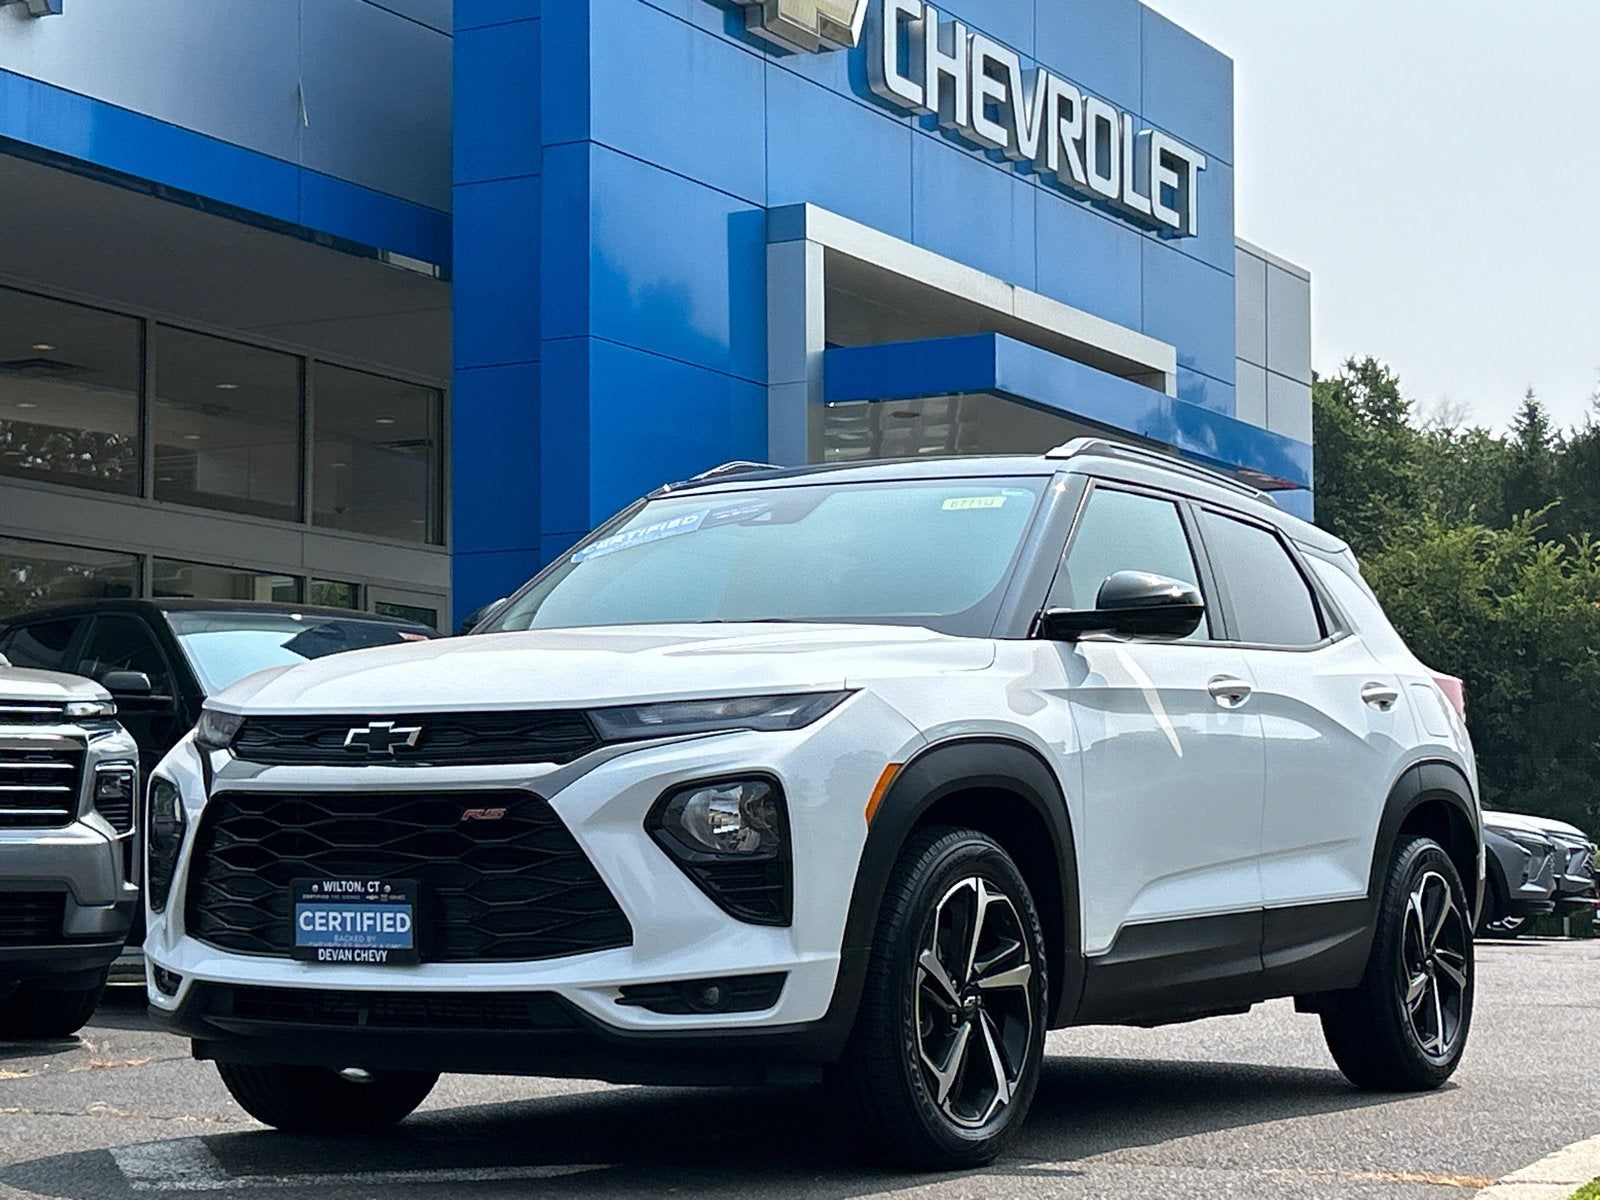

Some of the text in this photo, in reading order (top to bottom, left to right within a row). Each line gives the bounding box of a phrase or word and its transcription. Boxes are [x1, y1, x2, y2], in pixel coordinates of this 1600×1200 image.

[874, 0, 1206, 237] CHEVROLET
[580, 514, 699, 555] CERTIFIED
[461, 807, 506, 821] RS
[323, 880, 381, 893] WILTON, CT
[299, 910, 412, 933] CERTIFIED
[318, 948, 388, 962] DEVAN CHEVY
